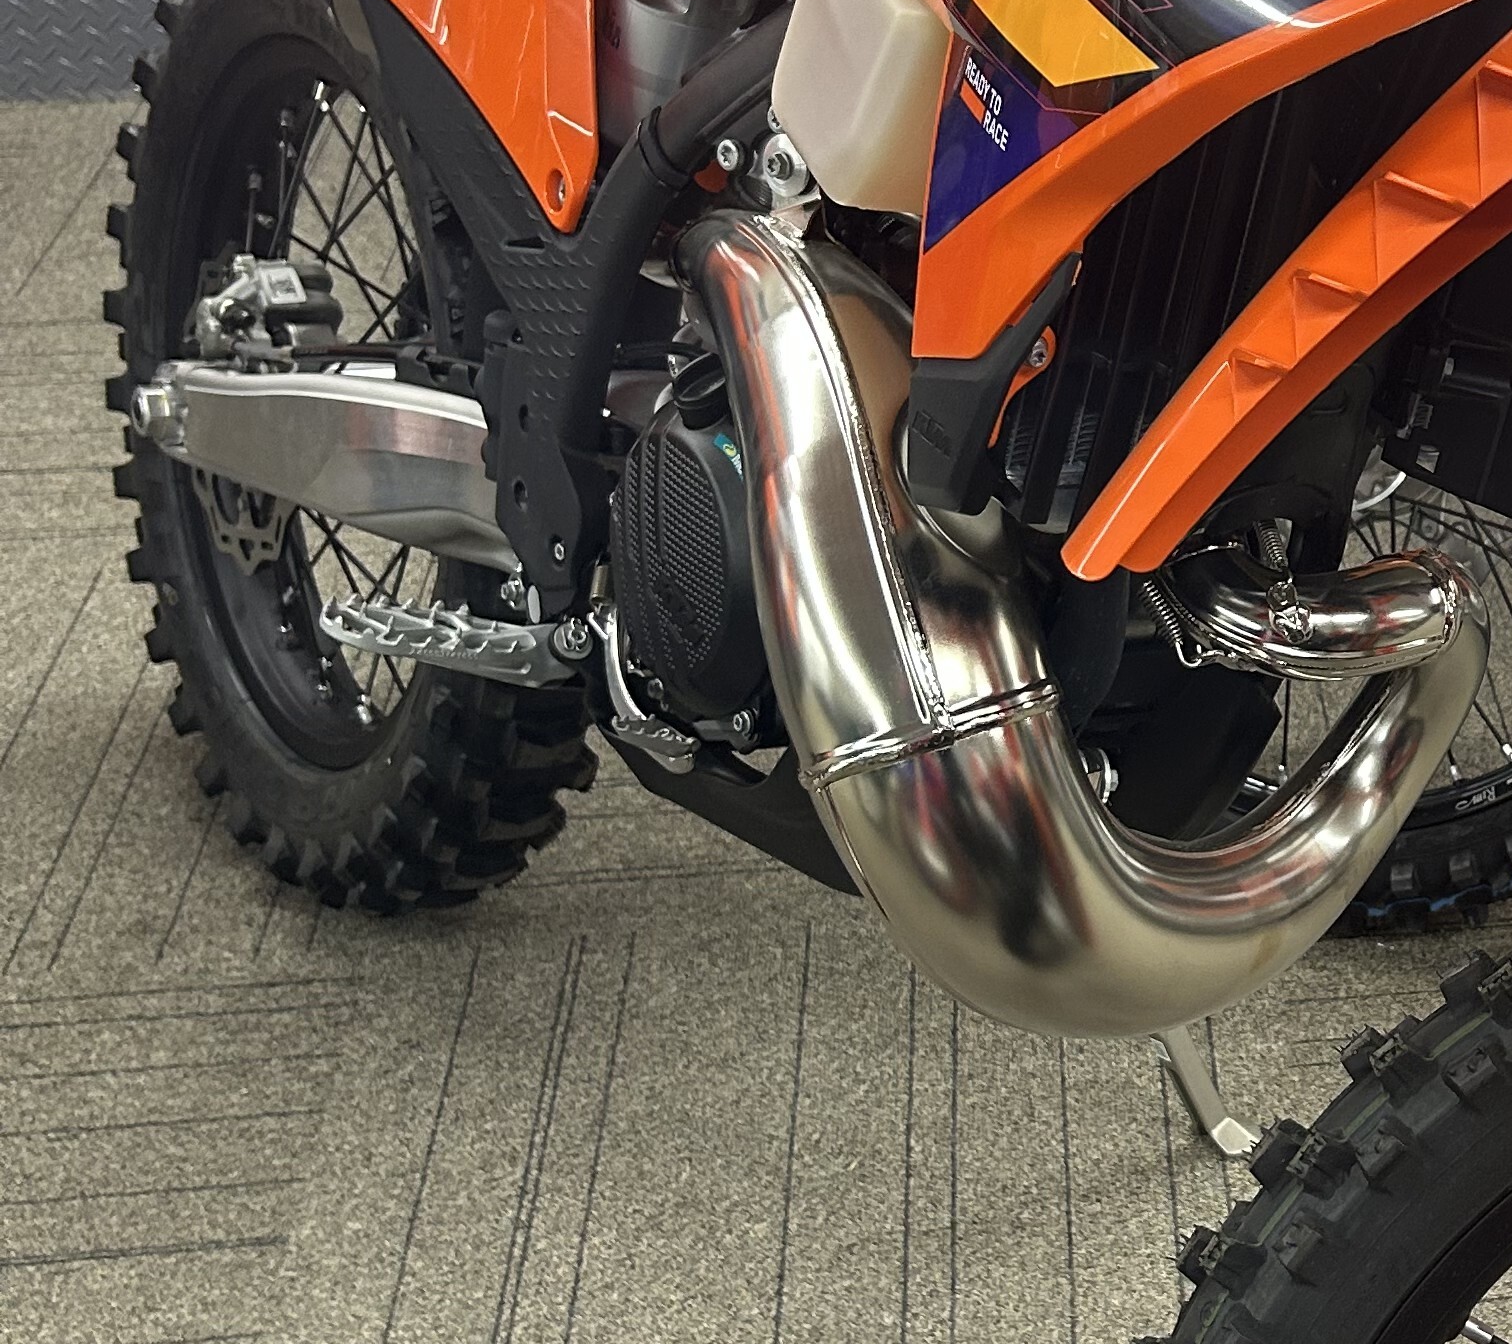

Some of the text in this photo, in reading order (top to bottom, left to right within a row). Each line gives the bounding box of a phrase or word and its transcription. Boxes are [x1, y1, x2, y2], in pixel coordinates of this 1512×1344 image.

[964, 57, 1003, 116] READY TO
[983, 110, 1009, 152] RACE
